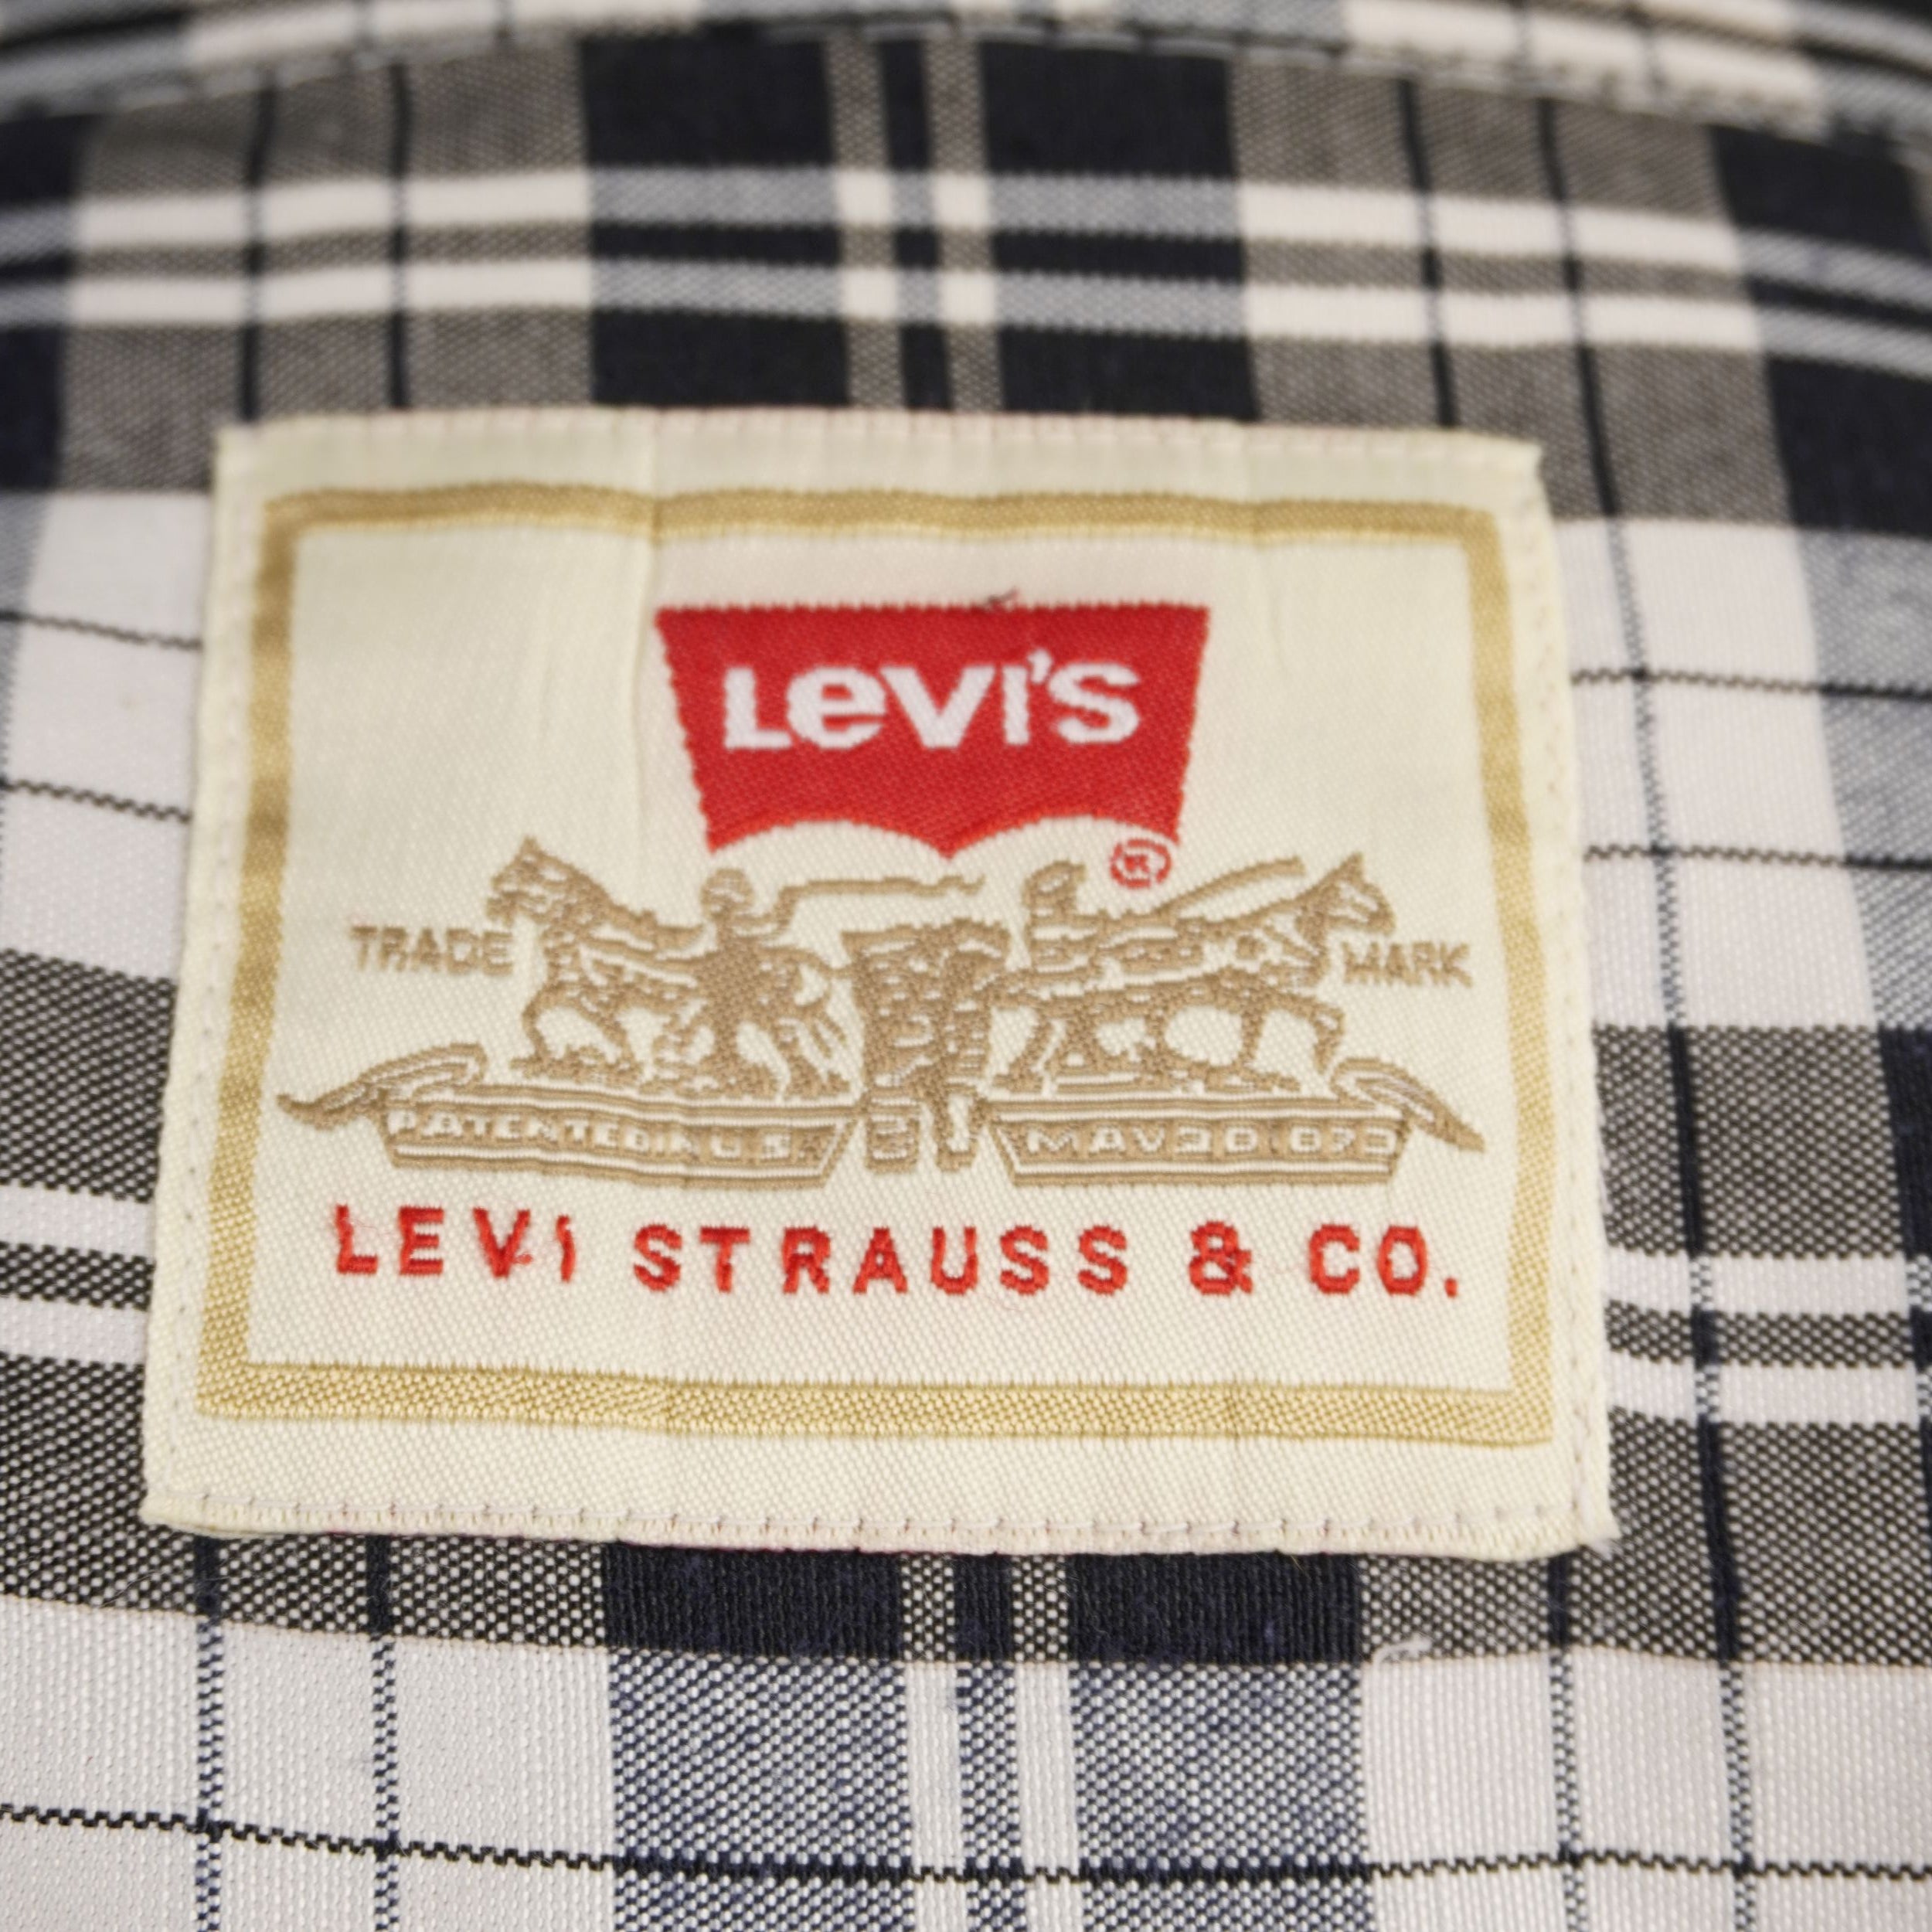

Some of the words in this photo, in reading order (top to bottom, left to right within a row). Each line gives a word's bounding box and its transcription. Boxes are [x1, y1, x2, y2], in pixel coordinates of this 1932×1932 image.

[350, 925, 514, 977] TRADE
[1342, 941, 1474, 990] MARK
[333, 1204, 577, 1283] LEVI
[633, 1223, 1128, 1296] STRAUSS
[1187, 1220, 1253, 1296] &
[1307, 1223, 1458, 1298] CO.
